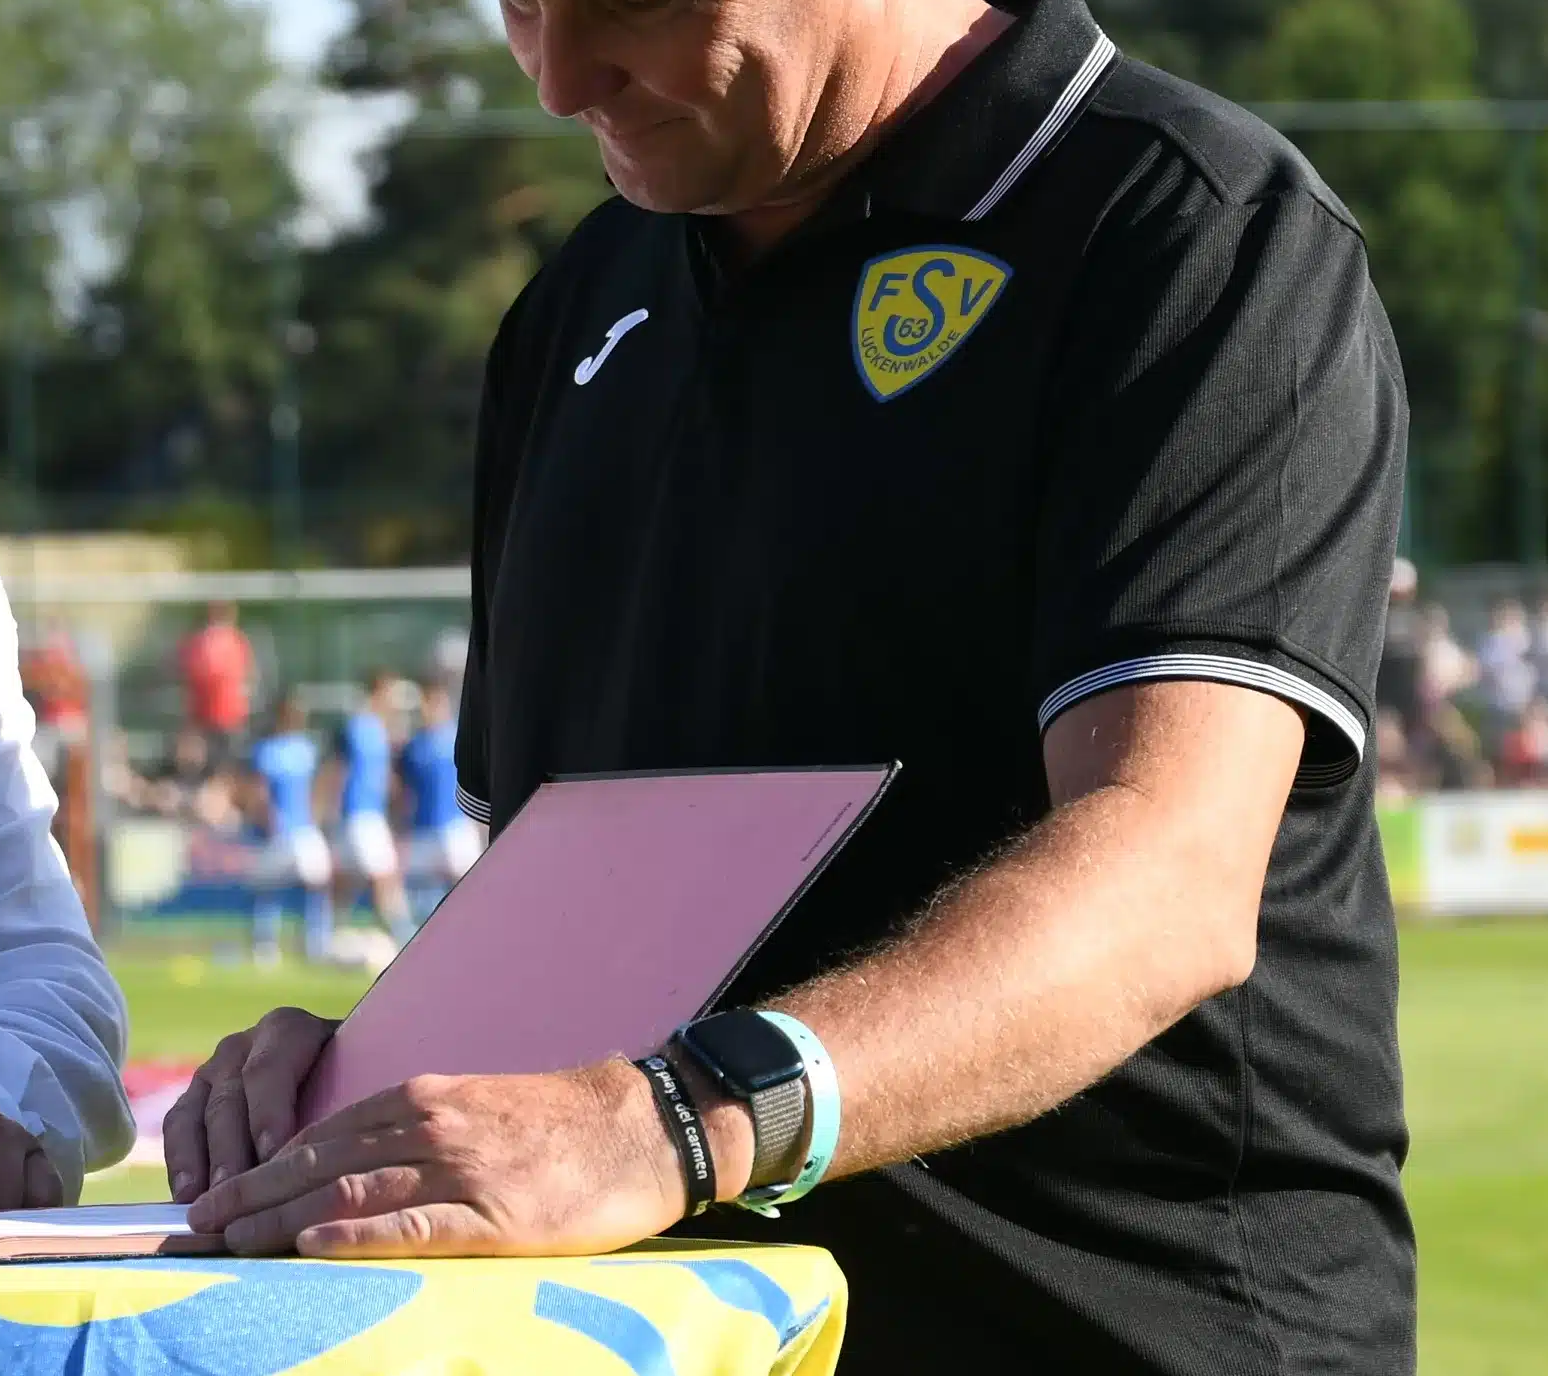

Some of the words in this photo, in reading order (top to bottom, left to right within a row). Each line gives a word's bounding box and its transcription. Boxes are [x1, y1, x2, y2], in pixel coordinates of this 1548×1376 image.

[868, 258, 994, 356] FSV
[898, 317, 928, 339] 63
[861, 327, 960, 374] LUCKENWALDE
[656, 1070, 681, 1101] playa
[674, 1102, 696, 1124] del
[685, 1126, 708, 1180] carmen
